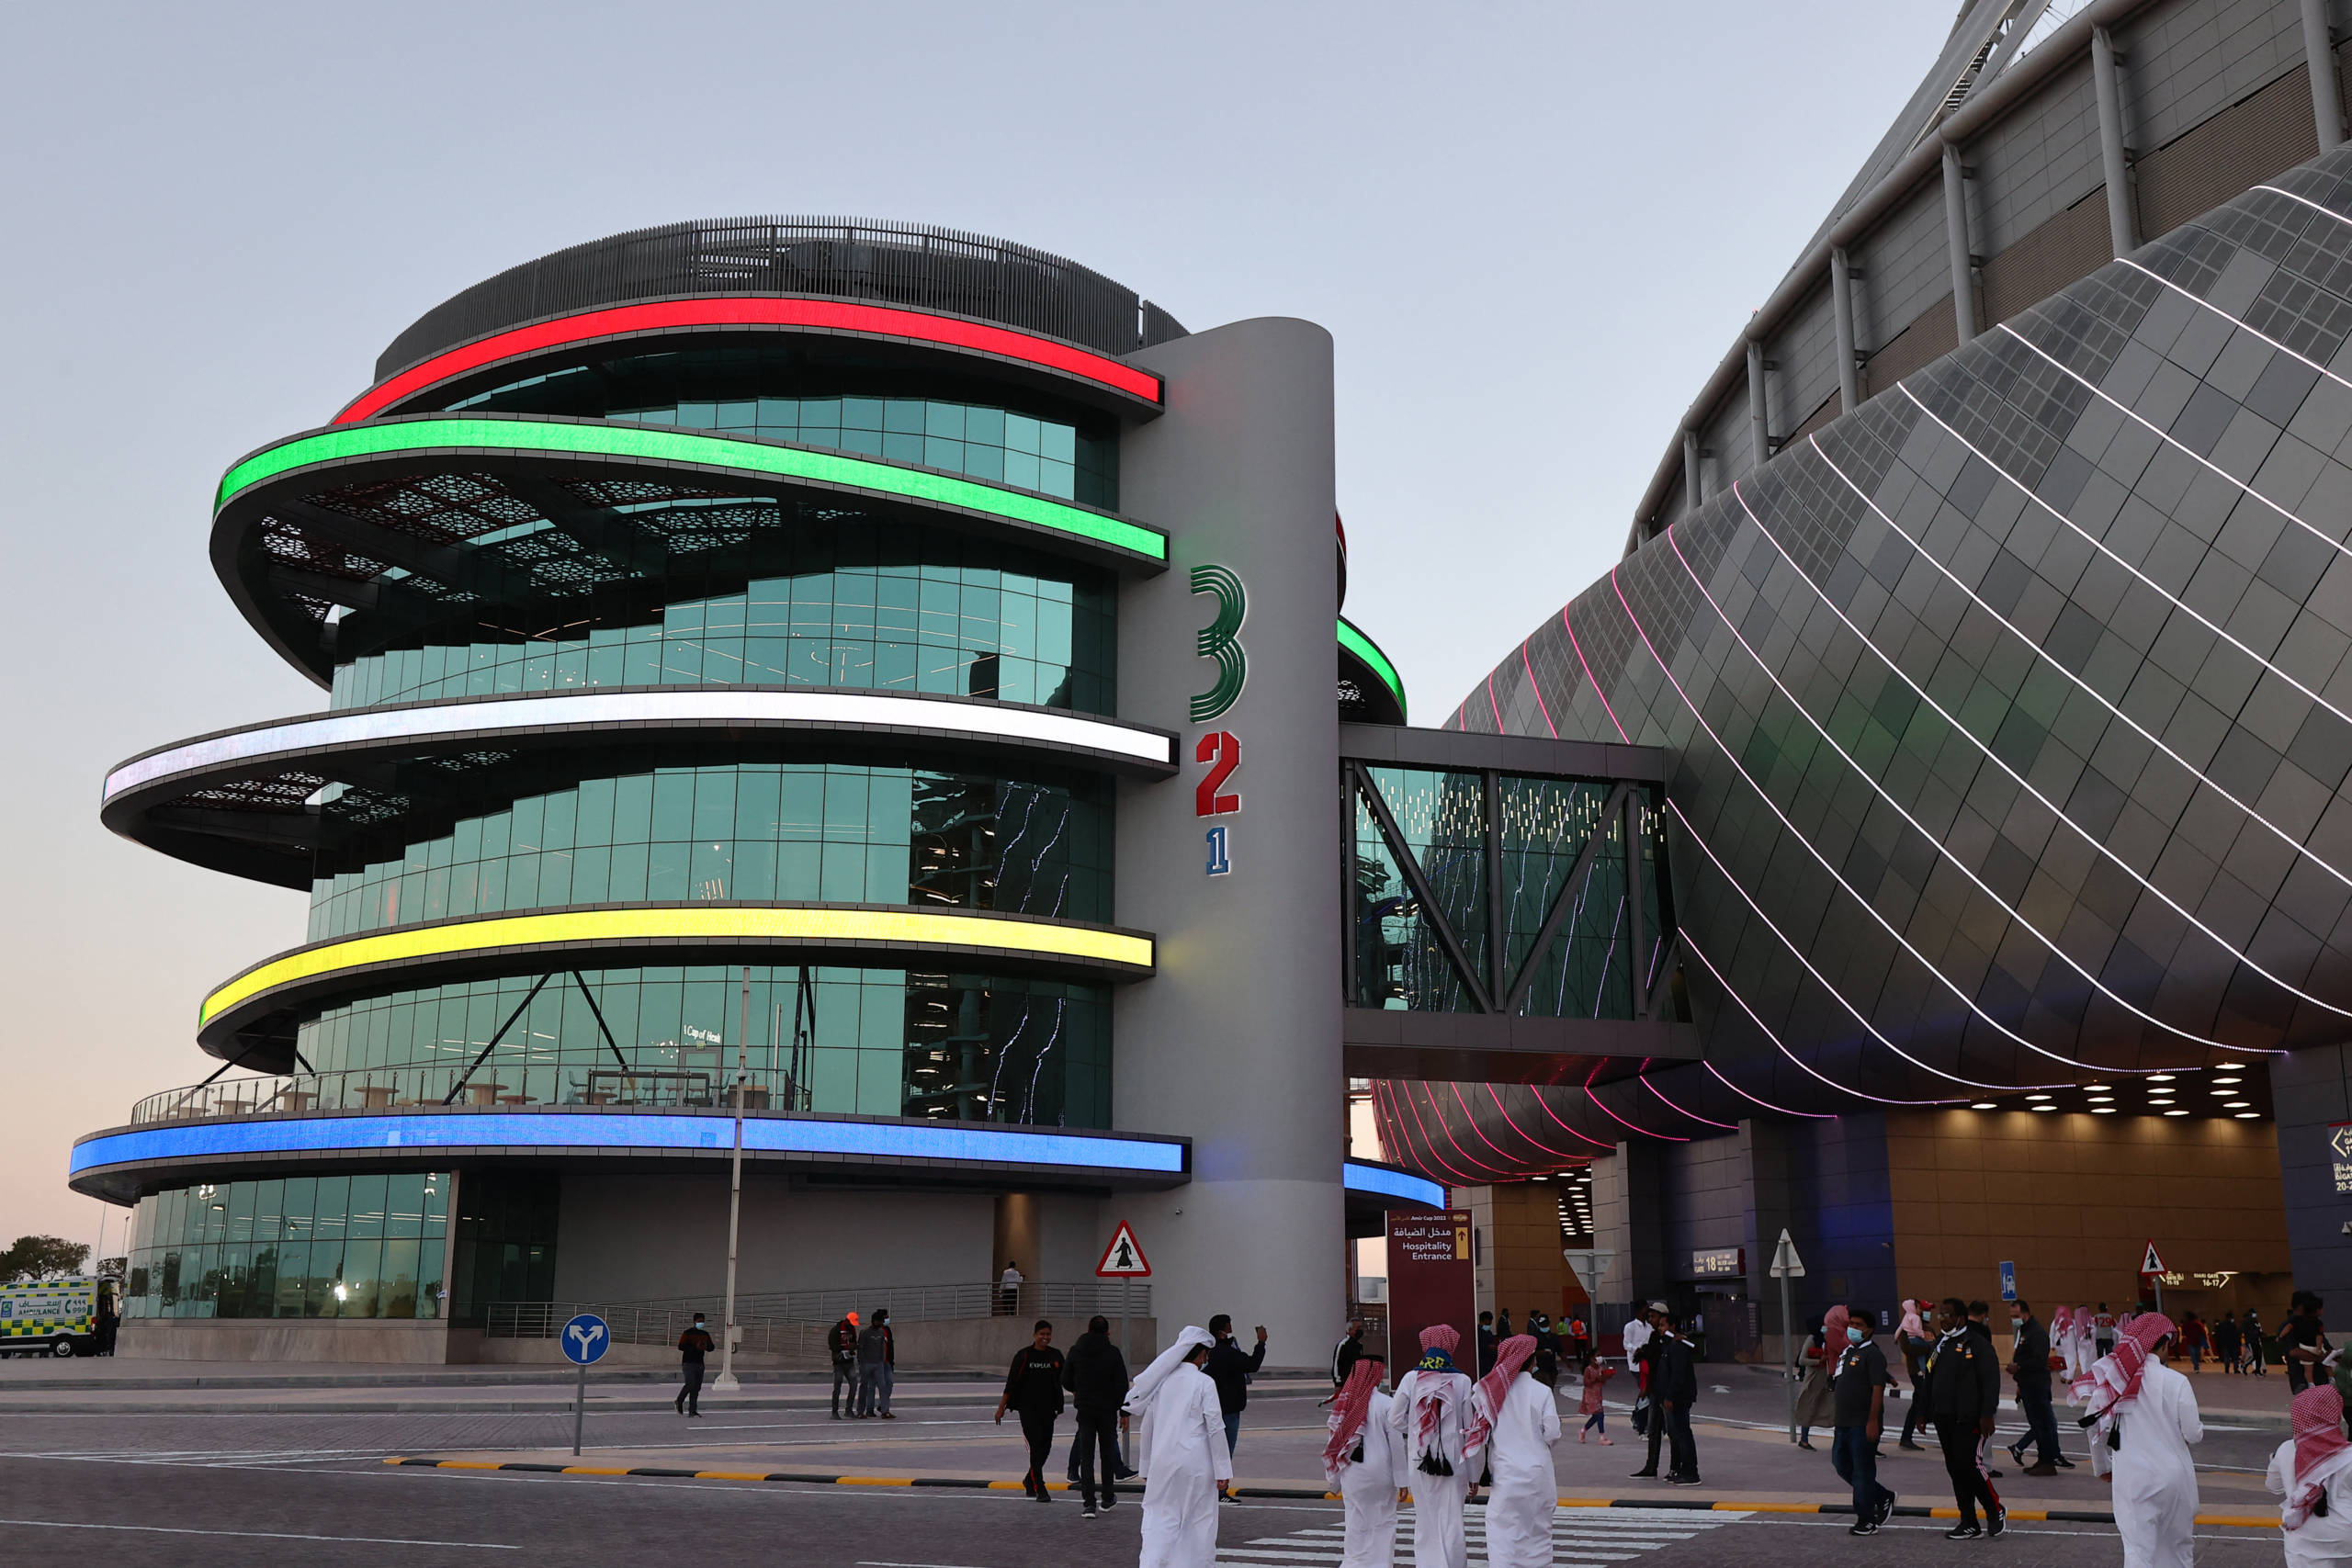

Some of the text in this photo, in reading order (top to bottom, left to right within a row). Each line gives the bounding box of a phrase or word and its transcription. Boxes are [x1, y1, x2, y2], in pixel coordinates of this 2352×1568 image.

[1191, 564, 1247, 723] 3
[1196, 731, 1241, 817] 2
[1206, 827, 1230, 875] 1
[1394, 1227, 1452, 1239] مدخل الضيافة
[1402, 1242, 1452, 1252] Hospitality
[1706, 1256, 1716, 1271] 18
